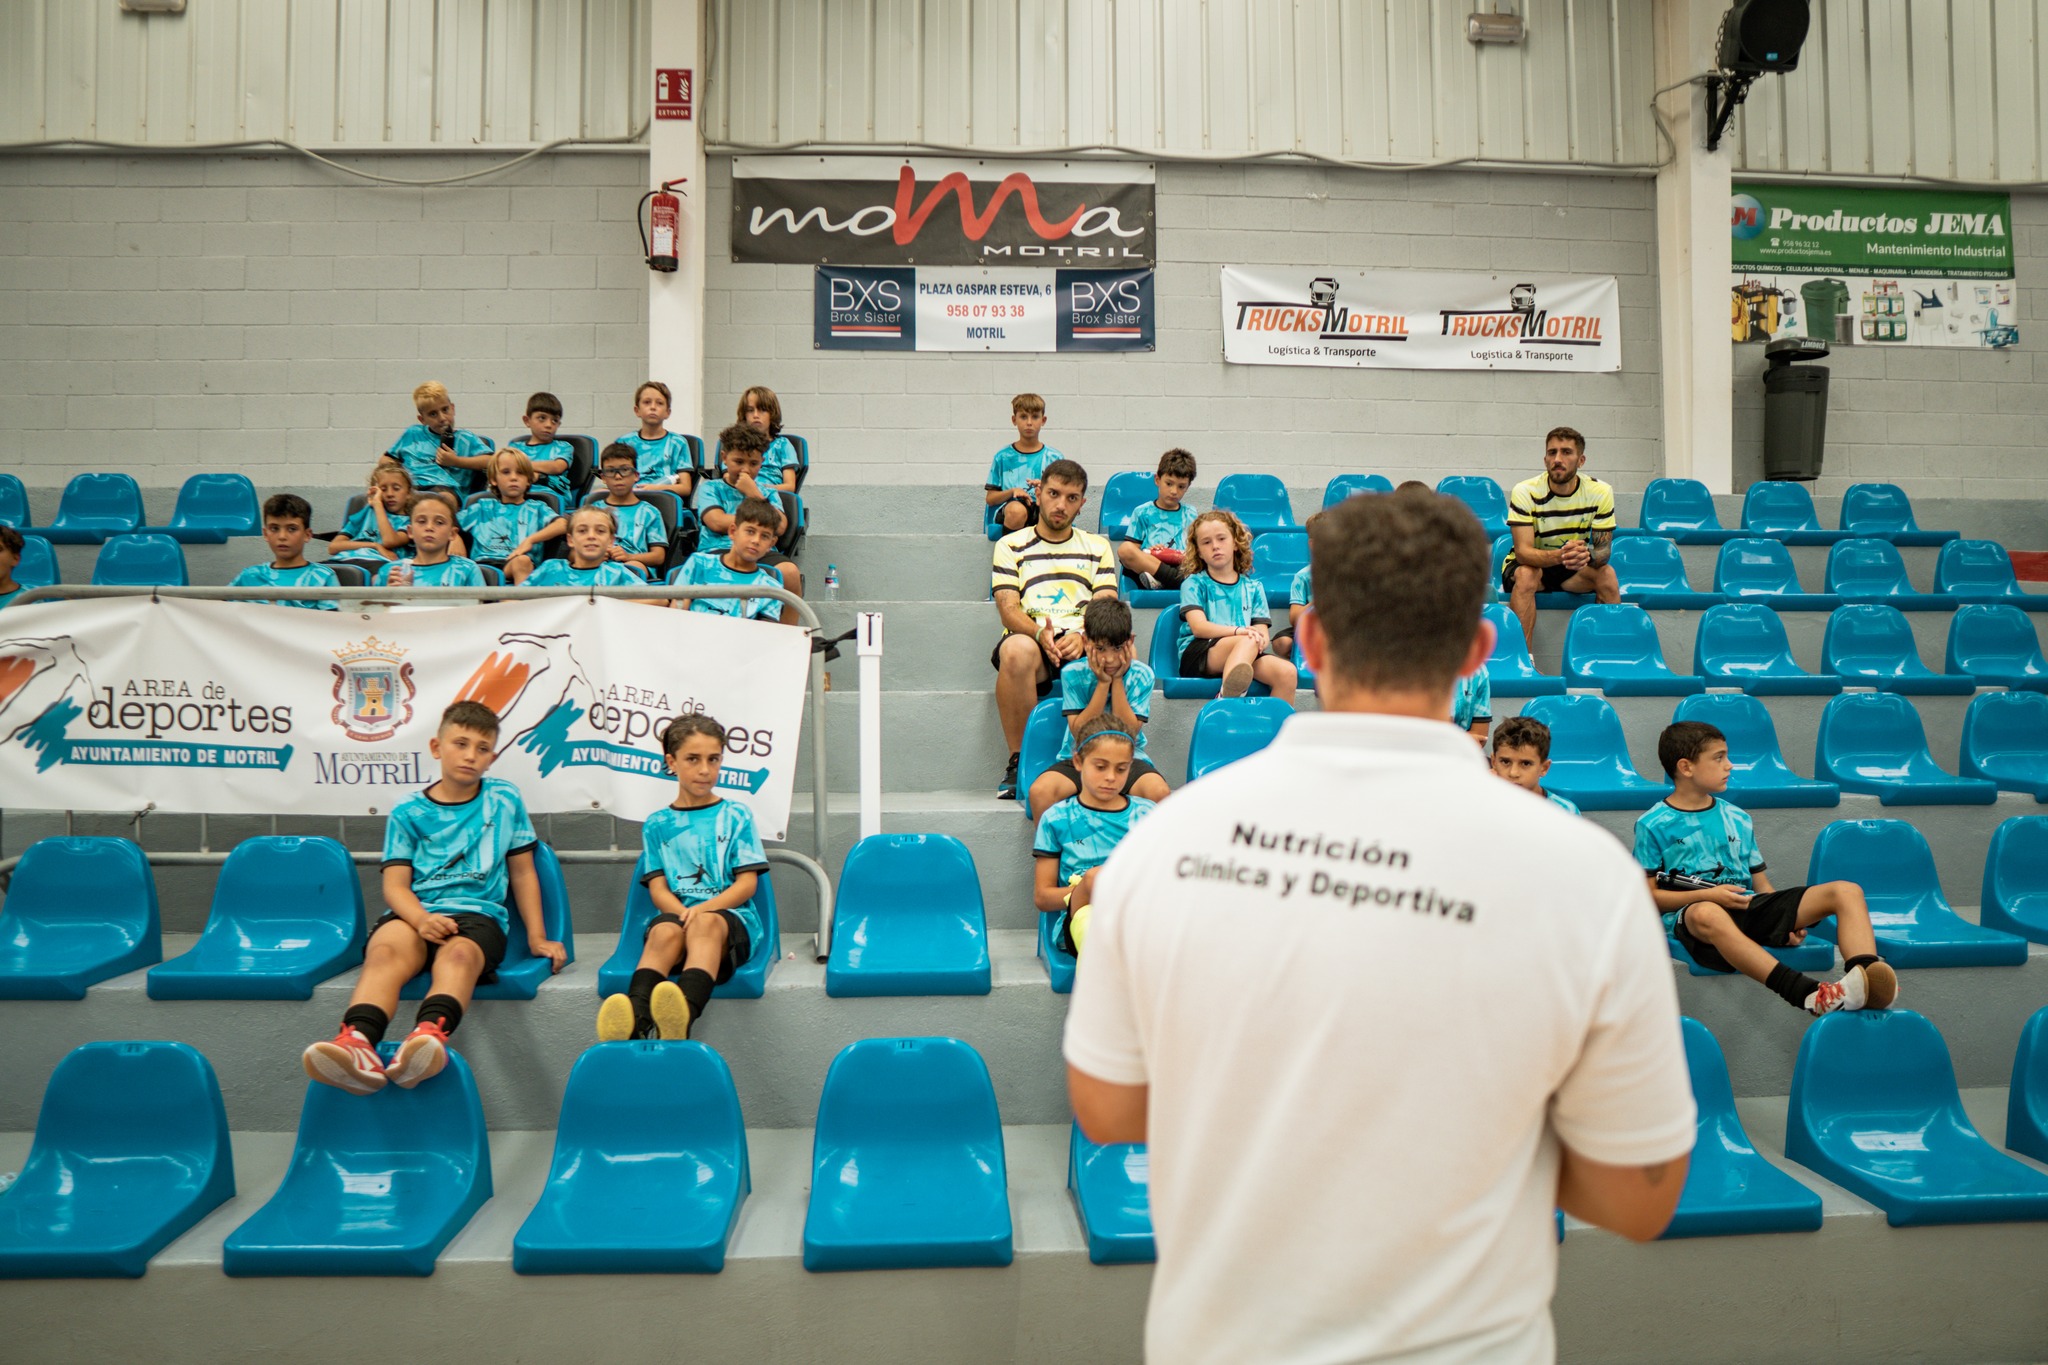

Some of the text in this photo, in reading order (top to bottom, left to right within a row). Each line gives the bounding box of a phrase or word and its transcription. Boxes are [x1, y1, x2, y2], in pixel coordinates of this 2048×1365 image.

[1768, 207, 2006, 236] Productos JEMA
[983, 245, 1144, 257] MOTRIL
[1760, 247, 1832, 256] www.productosjema.es
[1866, 243, 2006, 257] Mantenimiento Industrial
[831, 278, 901, 311] BXS
[920, 283, 1051, 297] PLAZA GASPAR ESTEVA, 6
[1071, 280, 1141, 313] BXS
[831, 312, 901, 323] Brox Sister
[947, 305, 1025, 317] 958 07 93 38
[1072, 313, 1140, 324] Brox Sister
[967, 327, 1006, 339] MOTRIL
[1269, 345, 1376, 358] Logística & Transporte
[1471, 350, 1574, 361] Logística & Transporte
[122, 679, 226, 700] AREA de
[606, 683, 705, 716] AREA de
[87, 686, 292, 739] deportes
[589, 689, 773, 757] depoes
[71, 746, 280, 765] AYUNTAMIENTO DE MOTRIL
[341, 752, 398, 762] AYUNTAMIENTO
[313, 751, 432, 785] MOTRIL
[571, 748, 661, 774] AYUNMIENTO
[718, 769, 752, 787] TRIL
[1232, 823, 1411, 869] Nutrición
[1175, 856, 1477, 924] Clínica y Deportiva
